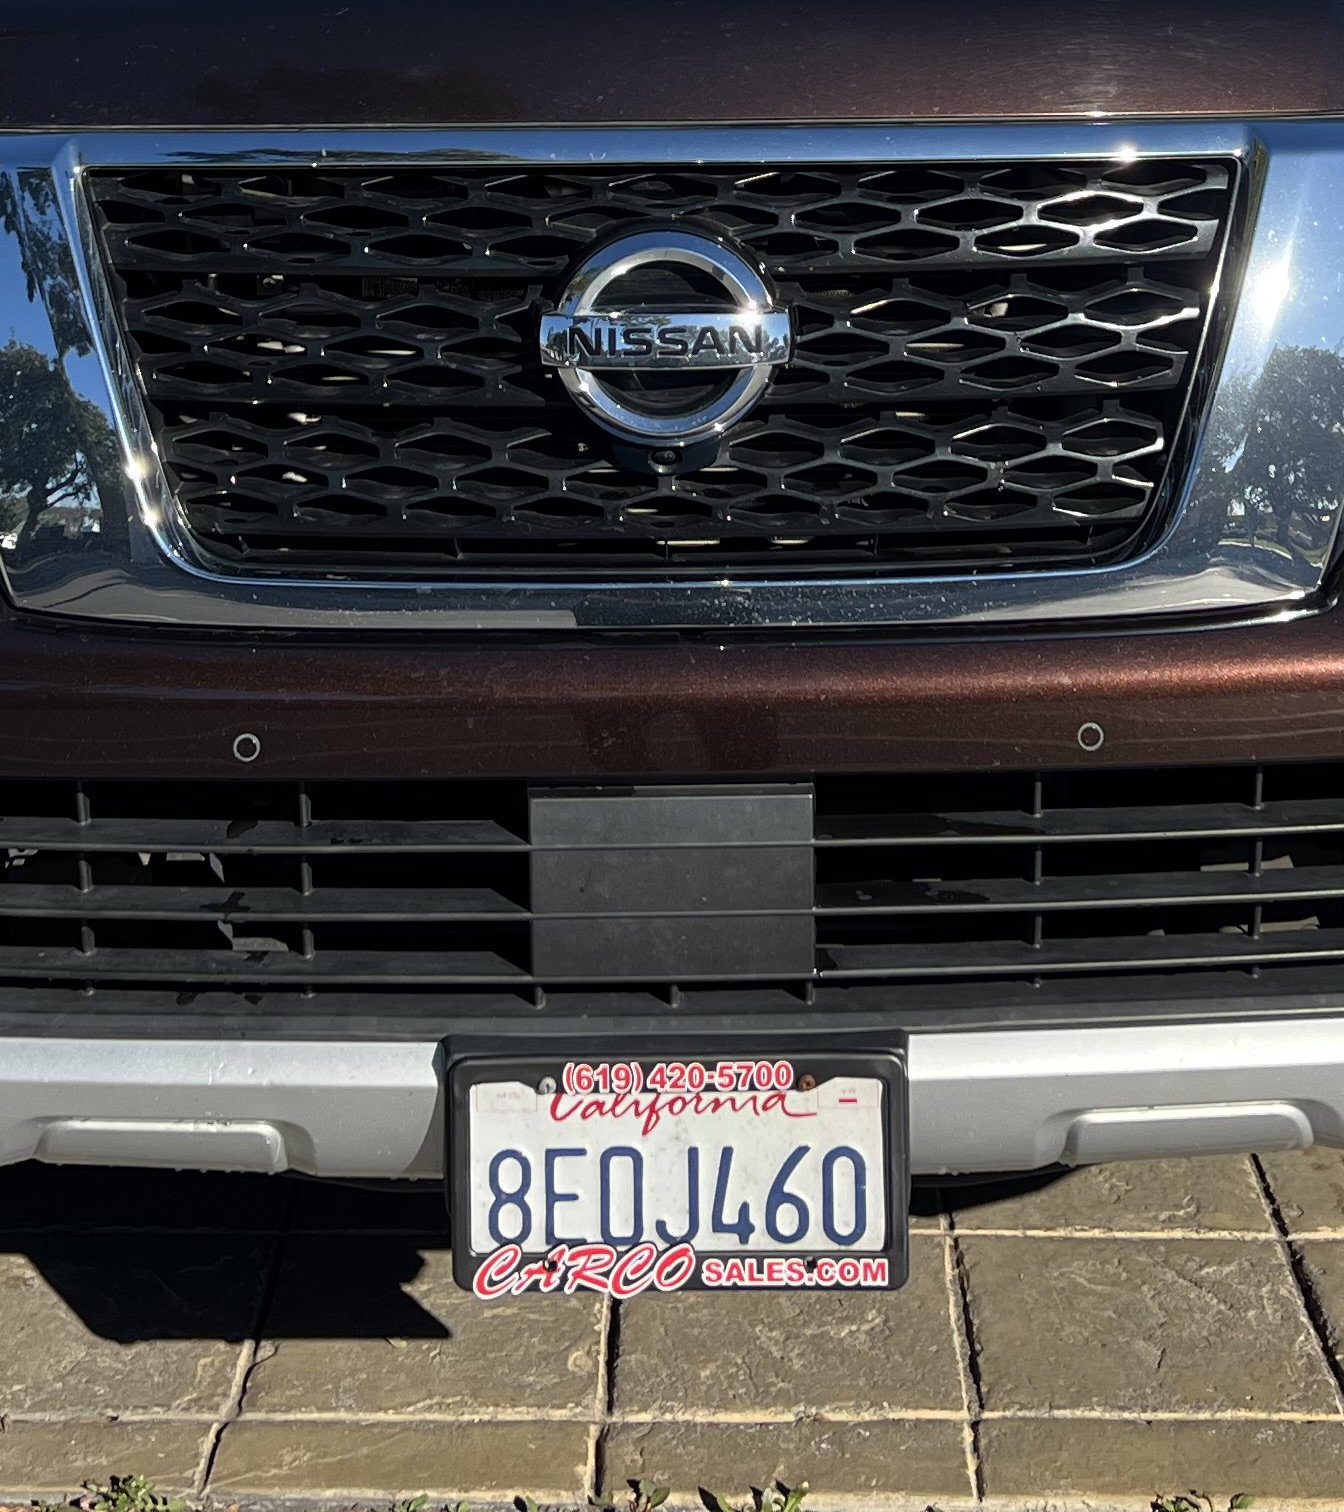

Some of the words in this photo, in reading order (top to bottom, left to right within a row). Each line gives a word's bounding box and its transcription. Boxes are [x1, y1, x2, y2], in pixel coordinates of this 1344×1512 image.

[567, 326, 763, 357] NISSAN
[562, 1061, 644, 1096] (619)
[646, 1059, 794, 1094] 420-5700
[549, 1090, 818, 1136] California
[473, 1242, 697, 1300] CARCO
[701, 1257, 889, 1287] SALES.COM
